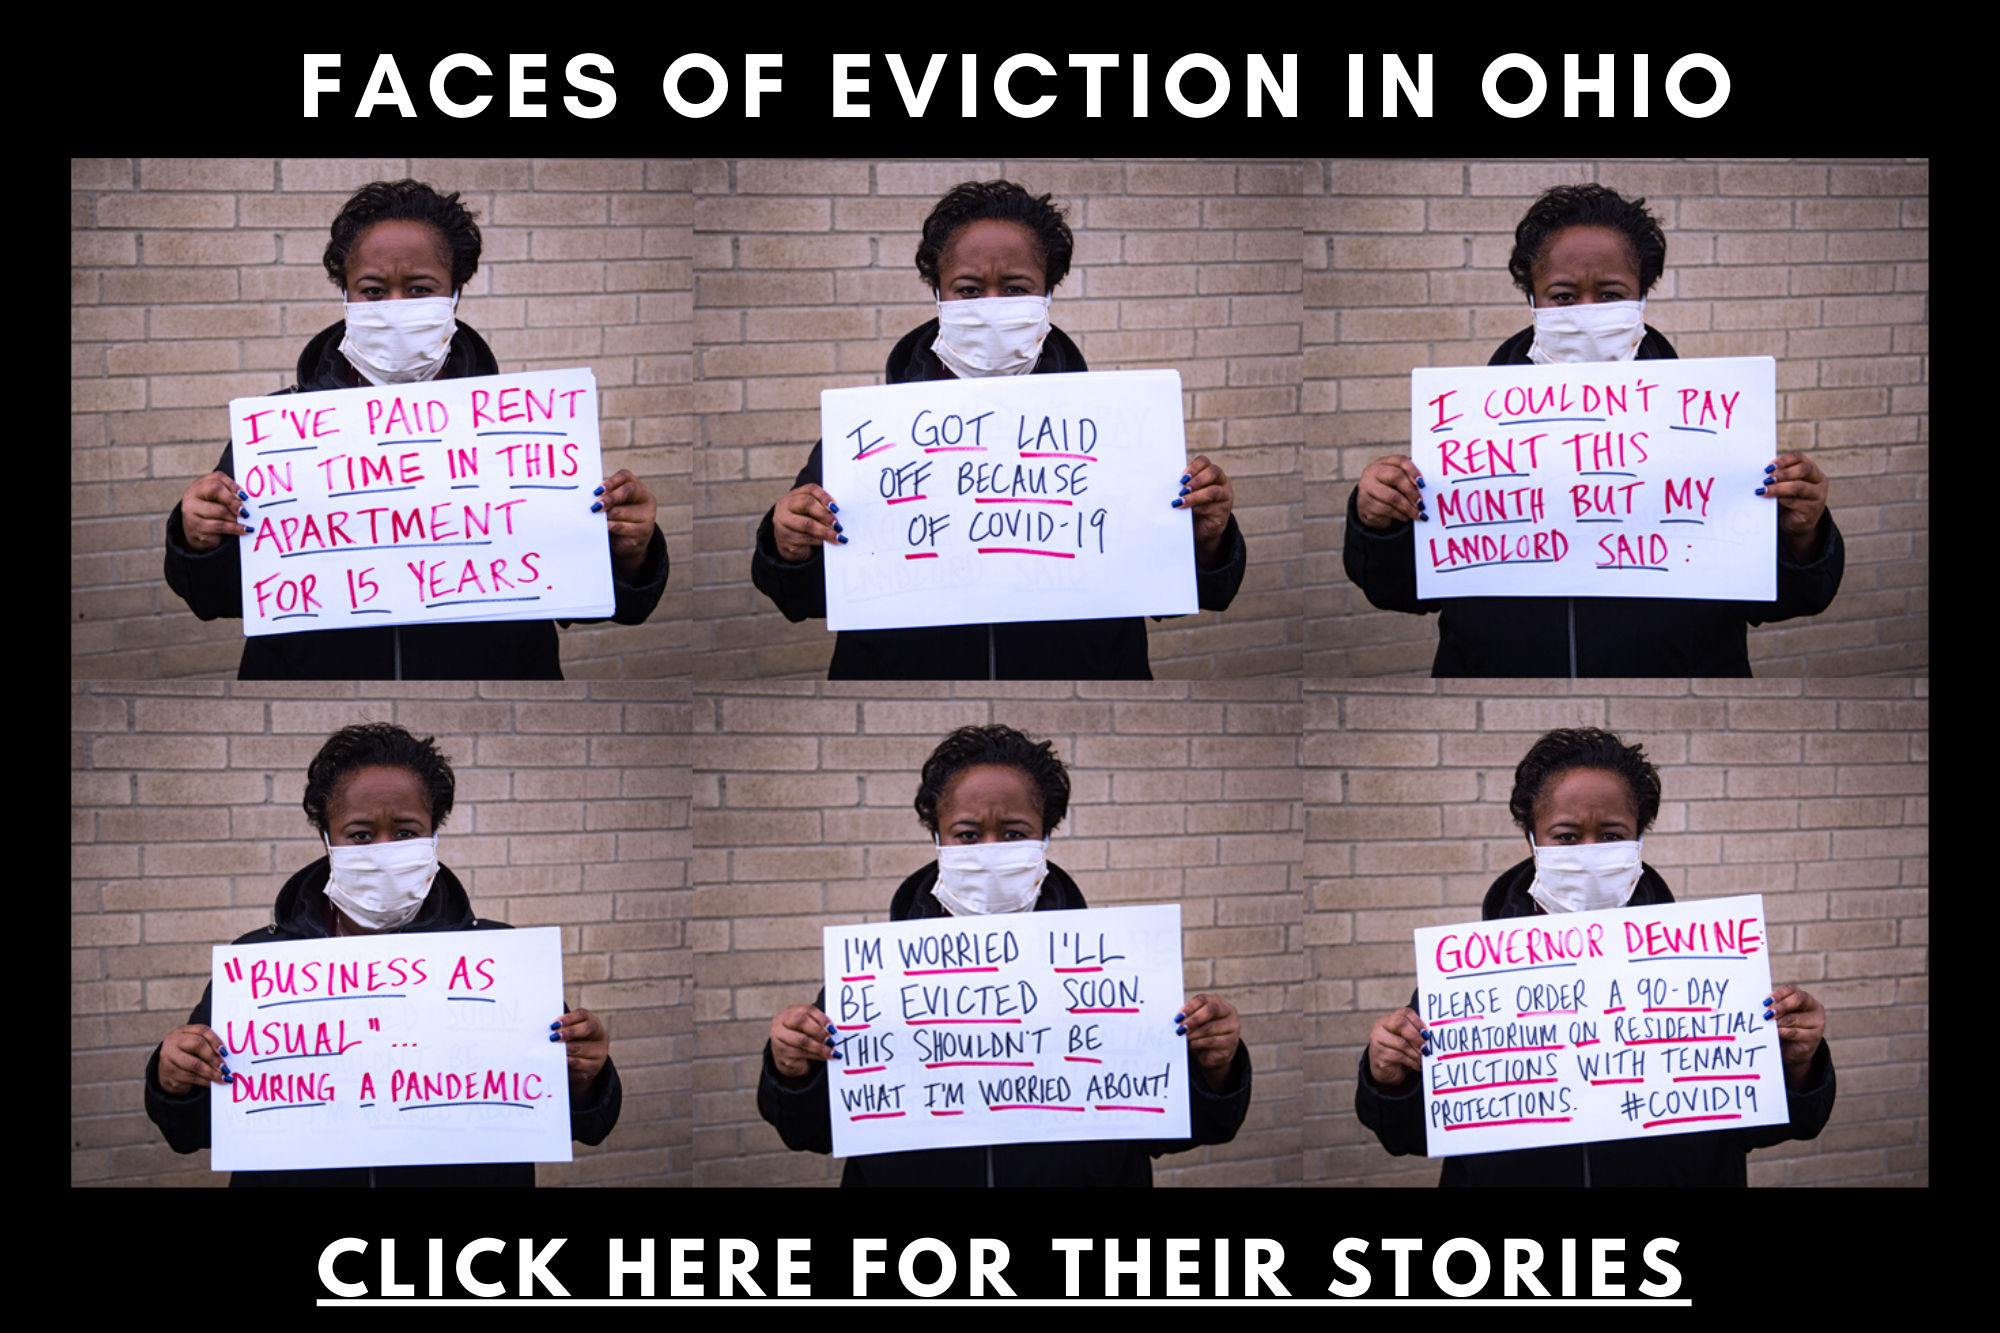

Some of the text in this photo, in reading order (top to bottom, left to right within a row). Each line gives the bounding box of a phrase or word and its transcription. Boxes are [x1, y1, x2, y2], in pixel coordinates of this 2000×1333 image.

[243, 387, 587, 445] I'VE PAID RENT
[1428, 379, 1740, 431] I COULDN'T PAY
[847, 420, 884, 460] I
[912, 410, 994, 446] GOT
[1018, 415, 1097, 453] LAID
[1437, 431, 1649, 476] RENT THIS
[245, 443, 578, 498] ON TIME IN THIS
[880, 461, 1087, 498] OFF BECAUSE
[1437, 477, 1714, 526] MONTH BUT MY
[252, 498, 527, 554] APARTMENT
[908, 514, 950, 546] OF
[969, 508, 1107, 553] COVID-19
[1429, 527, 1569, 567] LANDLORD
[253, 552, 552, 618] FOR 15 YEARS.
[845, 938, 883, 973] I'M
[899, 931, 1018, 968] WORRIED
[1050, 932, 1125, 964] I'LL
[1436, 918, 1764, 973] GOVERNOR DEWINE:
[224, 956, 494, 999] "BUSINESS AS
[841, 976, 1144, 1022] BE EVICTED SOON.
[1428, 978, 1729, 1020] PLEASE ORDER A 90-DAY
[836, 1031, 894, 1066] THIS
[913, 1027, 1051, 1062] SHOULDN'T
[1069, 1024, 1102, 1053] BE
[1426, 1012, 1765, 1057] MORATORIUM ON RESIDENTIAL
[231, 1069, 552, 1103] DURING A PANDEMIC.
[841, 1063, 1170, 1112] WHAT I'M WORRIED ABOUT!
[1431, 1045, 1767, 1091] EVICTIONS WITH TENANT
[1431, 1086, 1577, 1128] PROTECTIONS.
[1621, 1085, 1757, 1121] #COVID19
